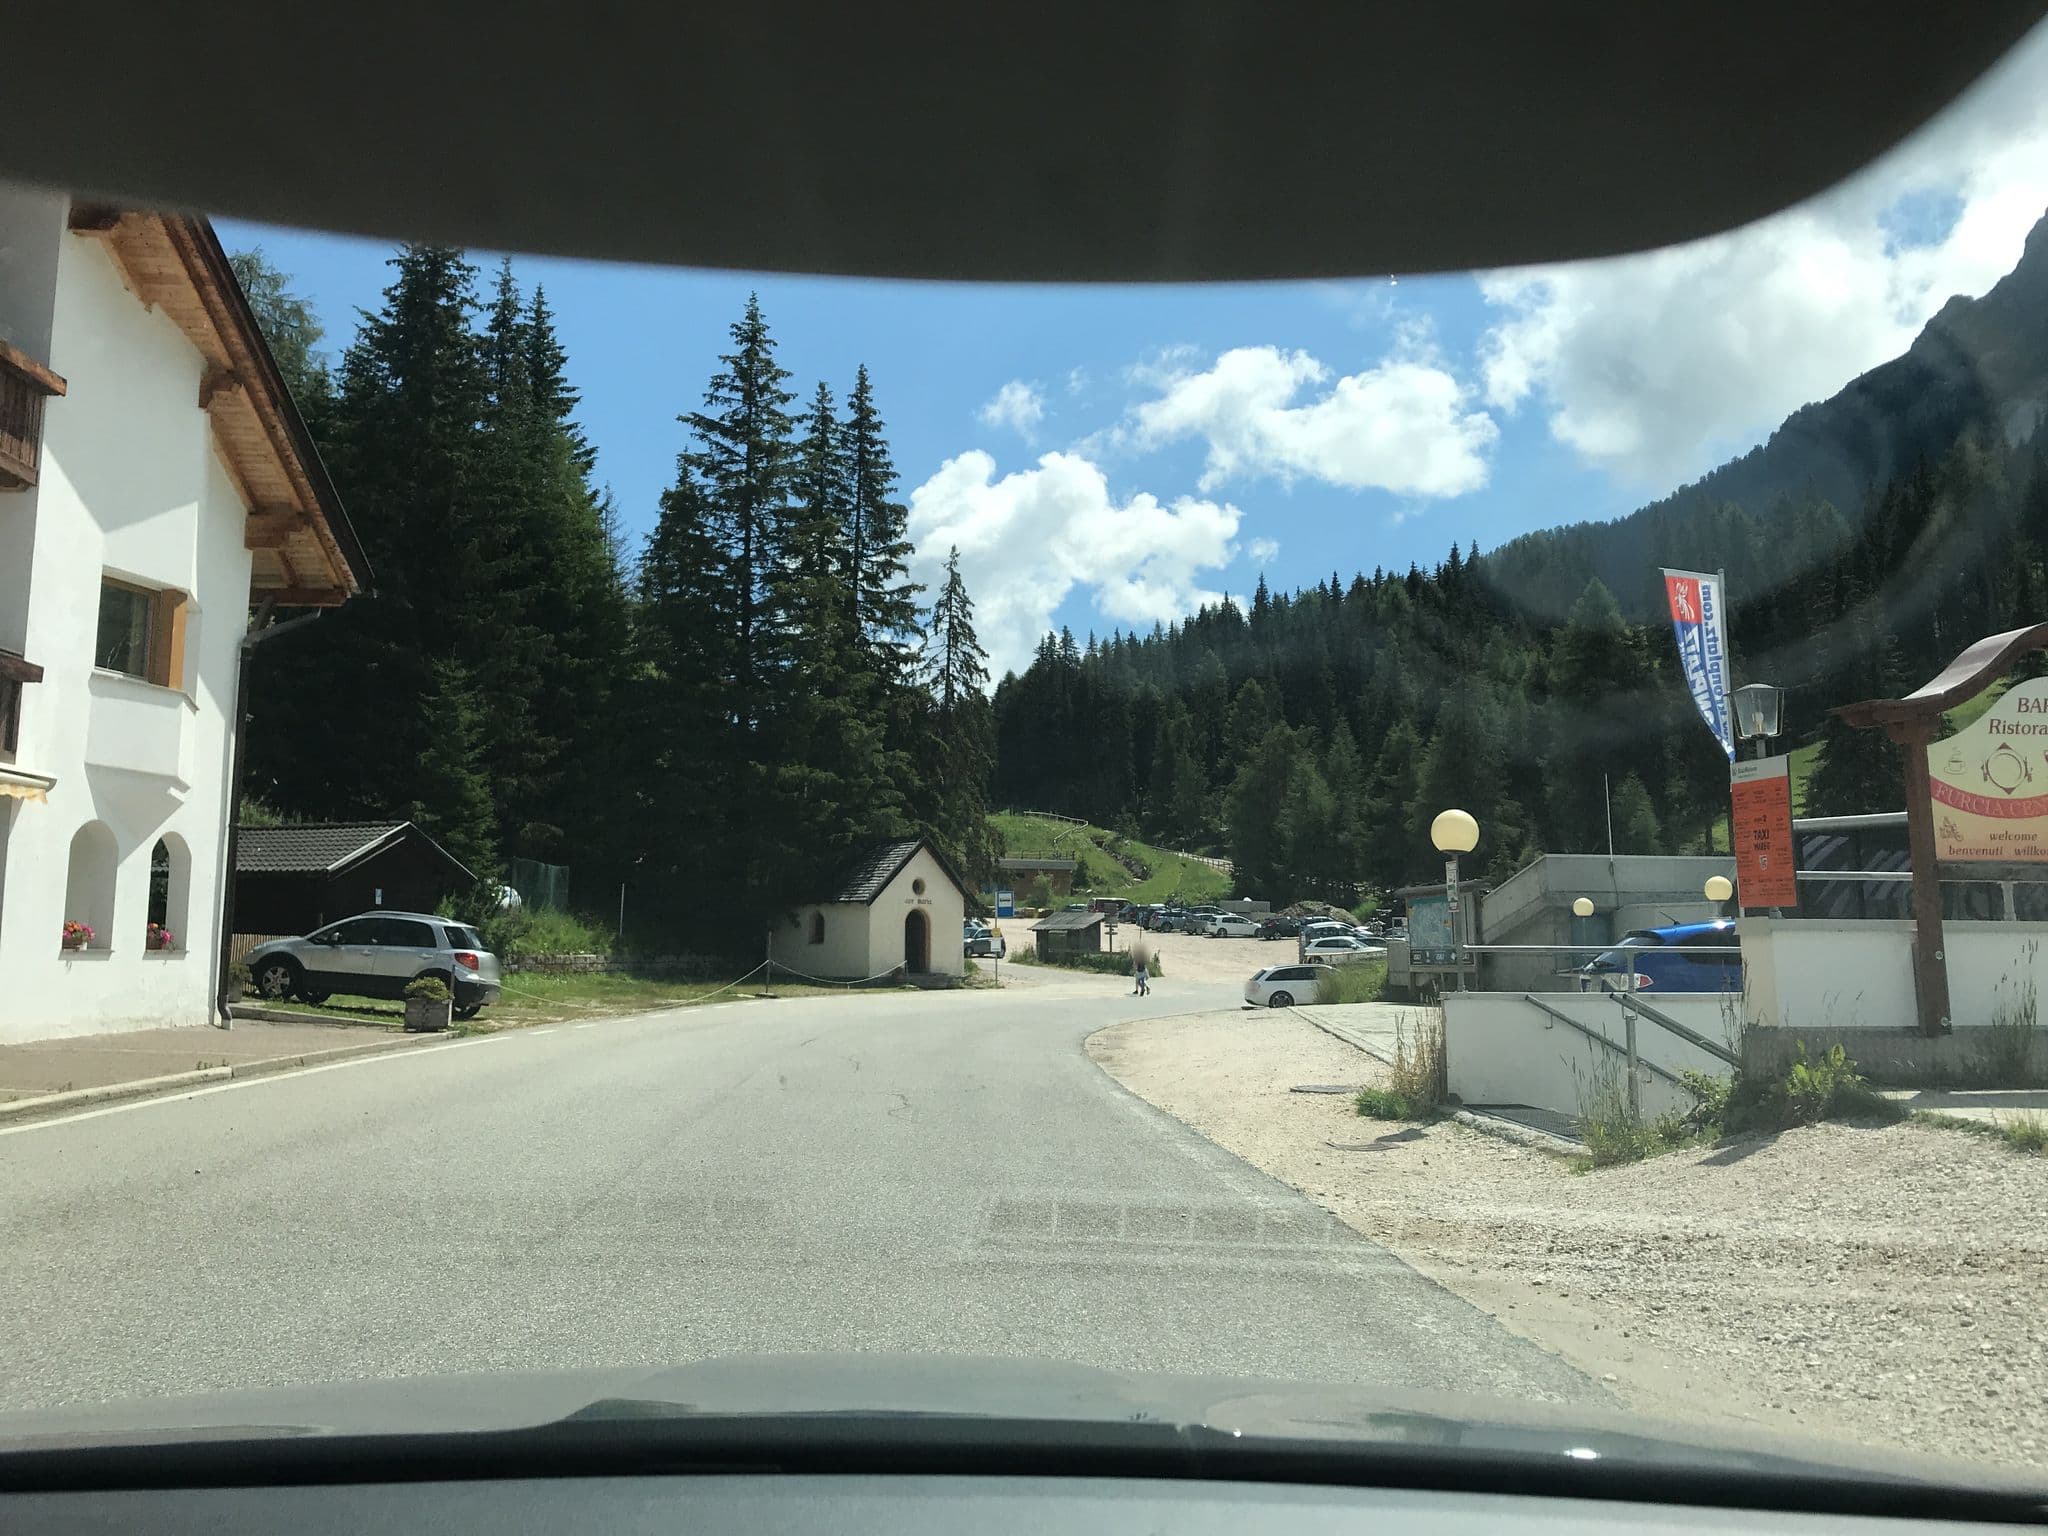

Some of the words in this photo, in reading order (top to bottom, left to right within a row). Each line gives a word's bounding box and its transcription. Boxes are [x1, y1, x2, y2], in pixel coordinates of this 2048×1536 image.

[1935, 783, 2005, 816] FURCIA
[1989, 830, 2038, 841] welcome
[1948, 845, 2004, 856] benvenuti
